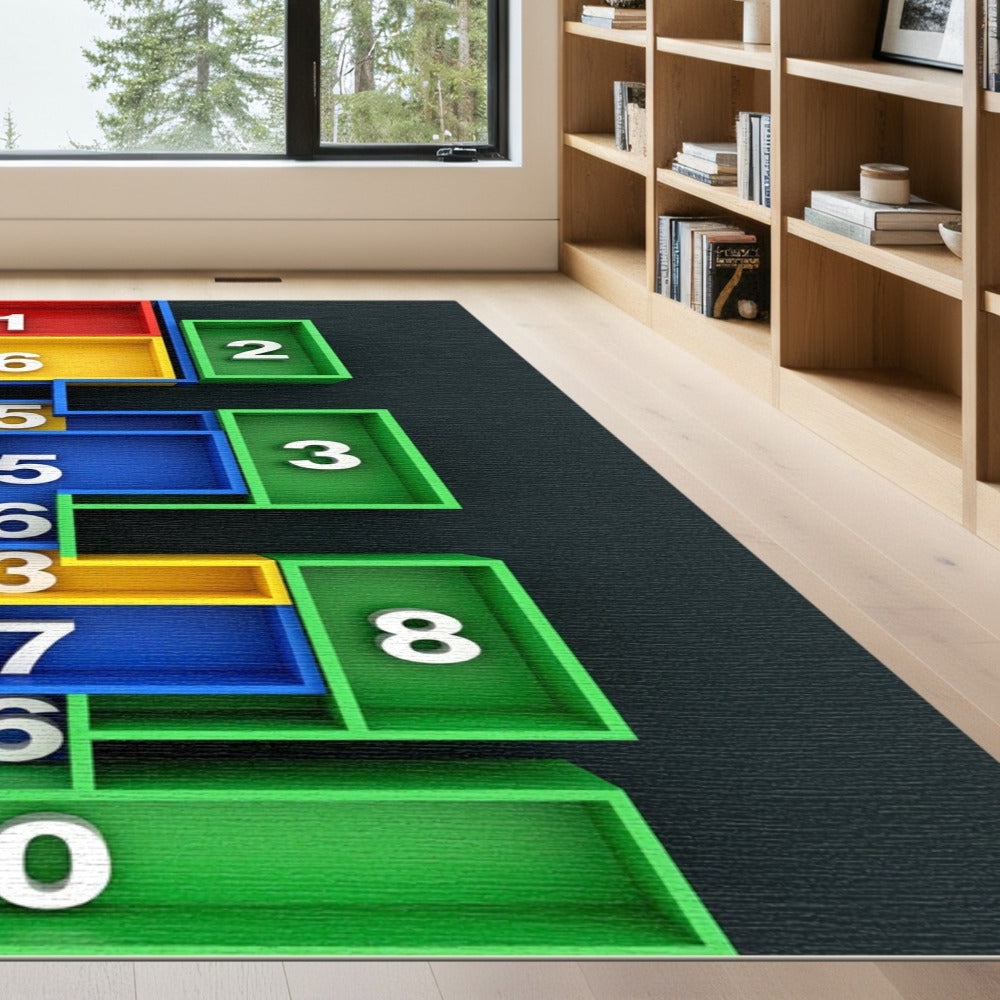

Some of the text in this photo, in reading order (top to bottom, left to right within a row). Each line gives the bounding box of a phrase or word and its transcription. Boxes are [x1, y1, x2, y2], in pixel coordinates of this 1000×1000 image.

[227, 339, 290, 360] 2
[282, 439, 362, 470] 3
[373, 609, 481, 665] 8
